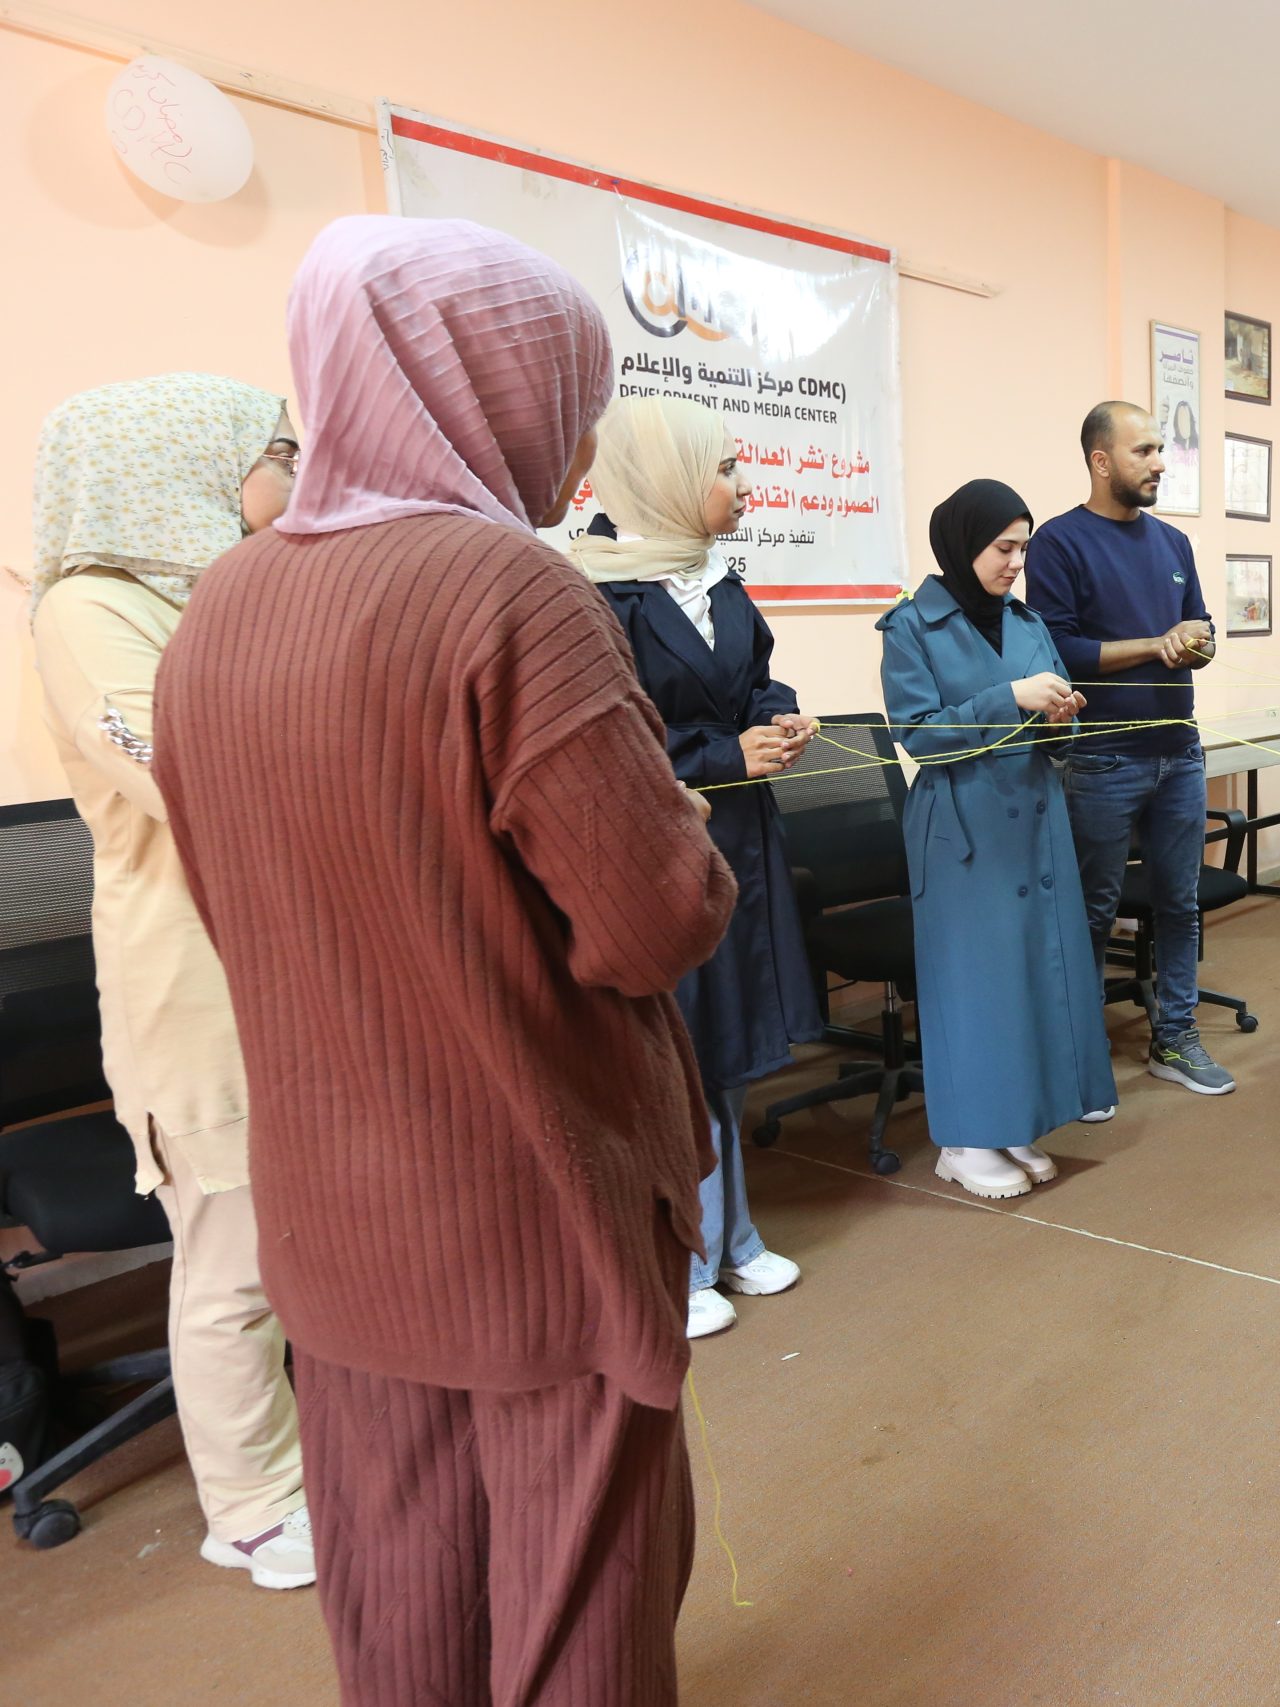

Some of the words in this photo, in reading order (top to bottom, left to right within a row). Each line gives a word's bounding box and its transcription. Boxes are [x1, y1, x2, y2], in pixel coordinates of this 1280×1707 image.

[621, 352, 692, 384] والإعلام
[698, 362, 752, 388] التنمية
[757, 371, 794, 397] مركز
[722, 397, 750, 414] AND
[754, 400, 791, 419] MEDIA
[795, 406, 837, 424] CENTER
[734, 437, 792, 467] العدالة
[831, 450, 870, 479] مشروع
[800, 494, 834, 517] ودعم
[837, 495, 880, 518] الصمود
[757, 527, 785, 547] مركز
[788, 529, 816, 548] تنفيذ
